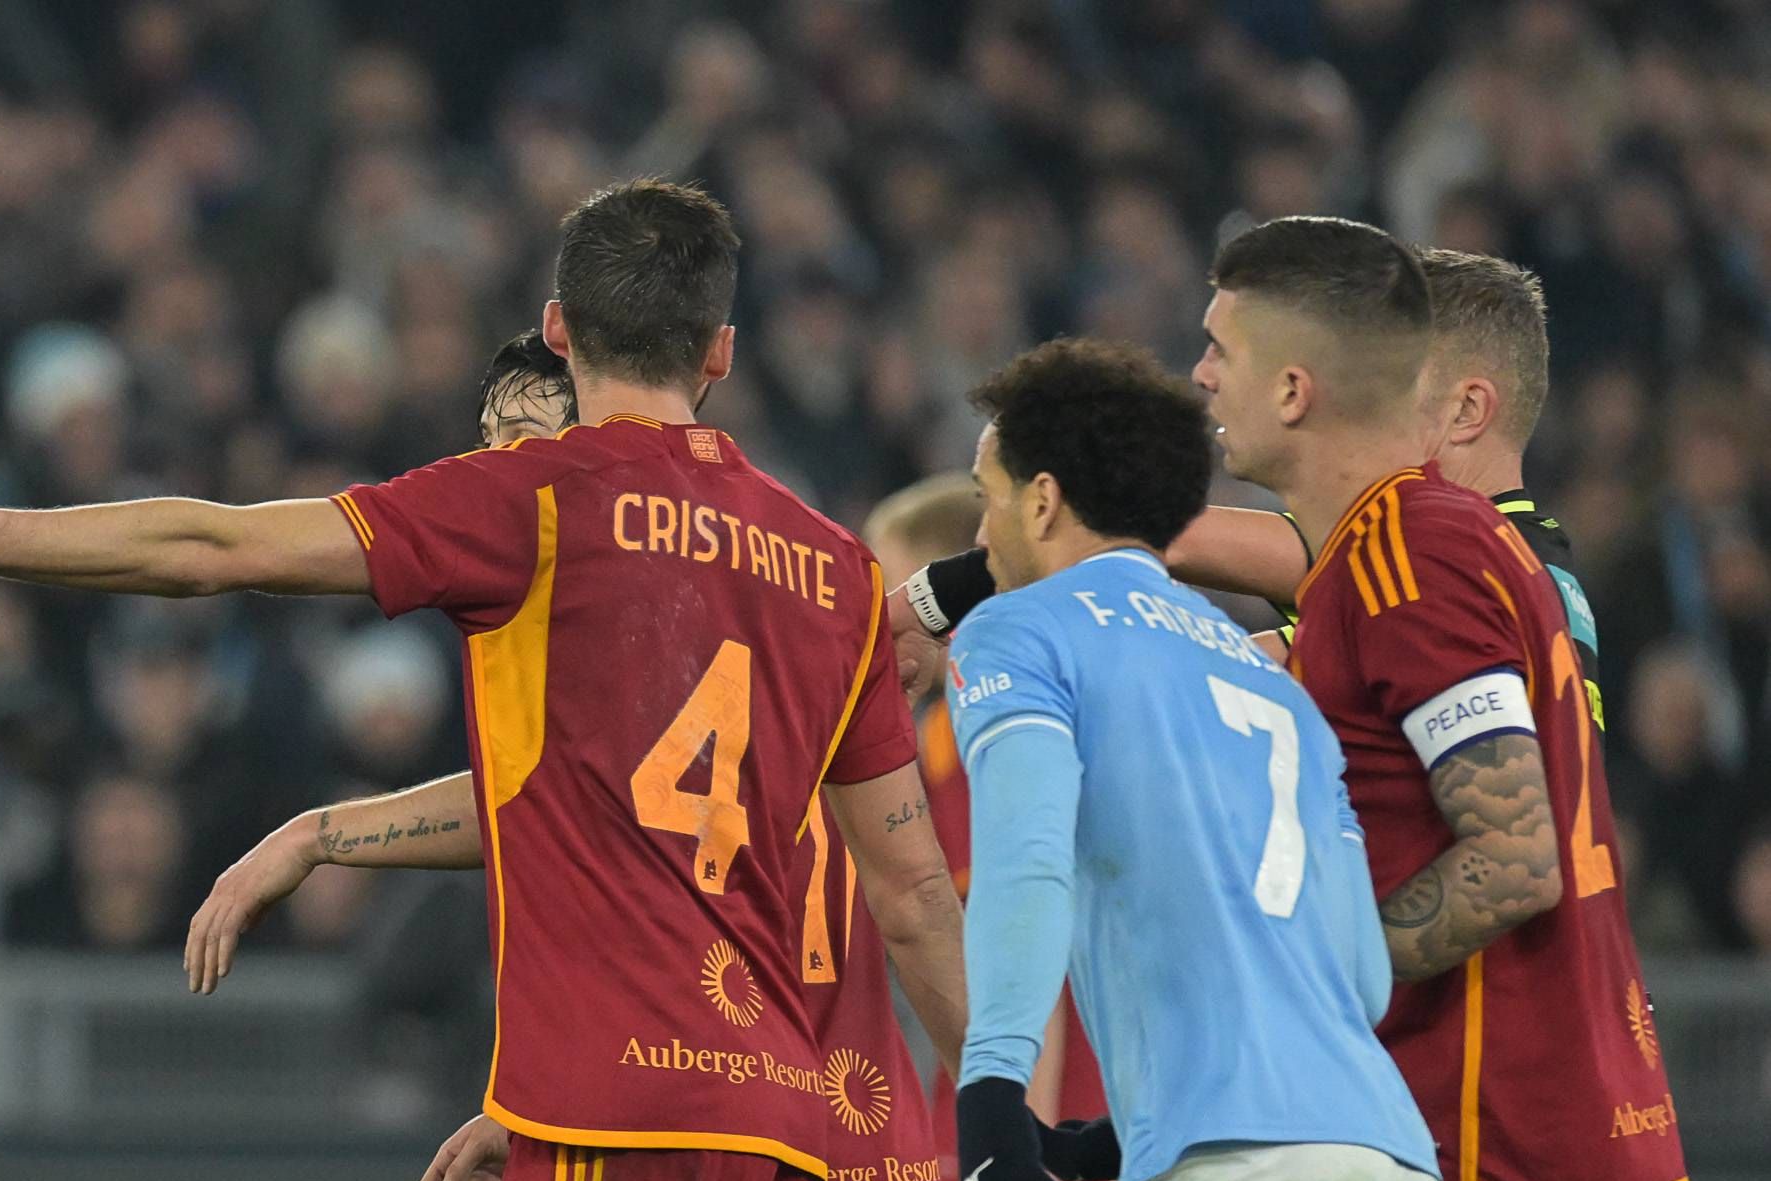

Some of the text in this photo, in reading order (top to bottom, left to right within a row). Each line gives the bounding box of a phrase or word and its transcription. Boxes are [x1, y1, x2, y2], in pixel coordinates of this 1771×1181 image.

[613, 493, 836, 610] CRISTANTE
[630, 639, 751, 896] 4
[1425, 691, 1504, 741] PEACE
[1206, 674, 1307, 919] 7
[619, 1037, 826, 1097] Auberge Resorts
